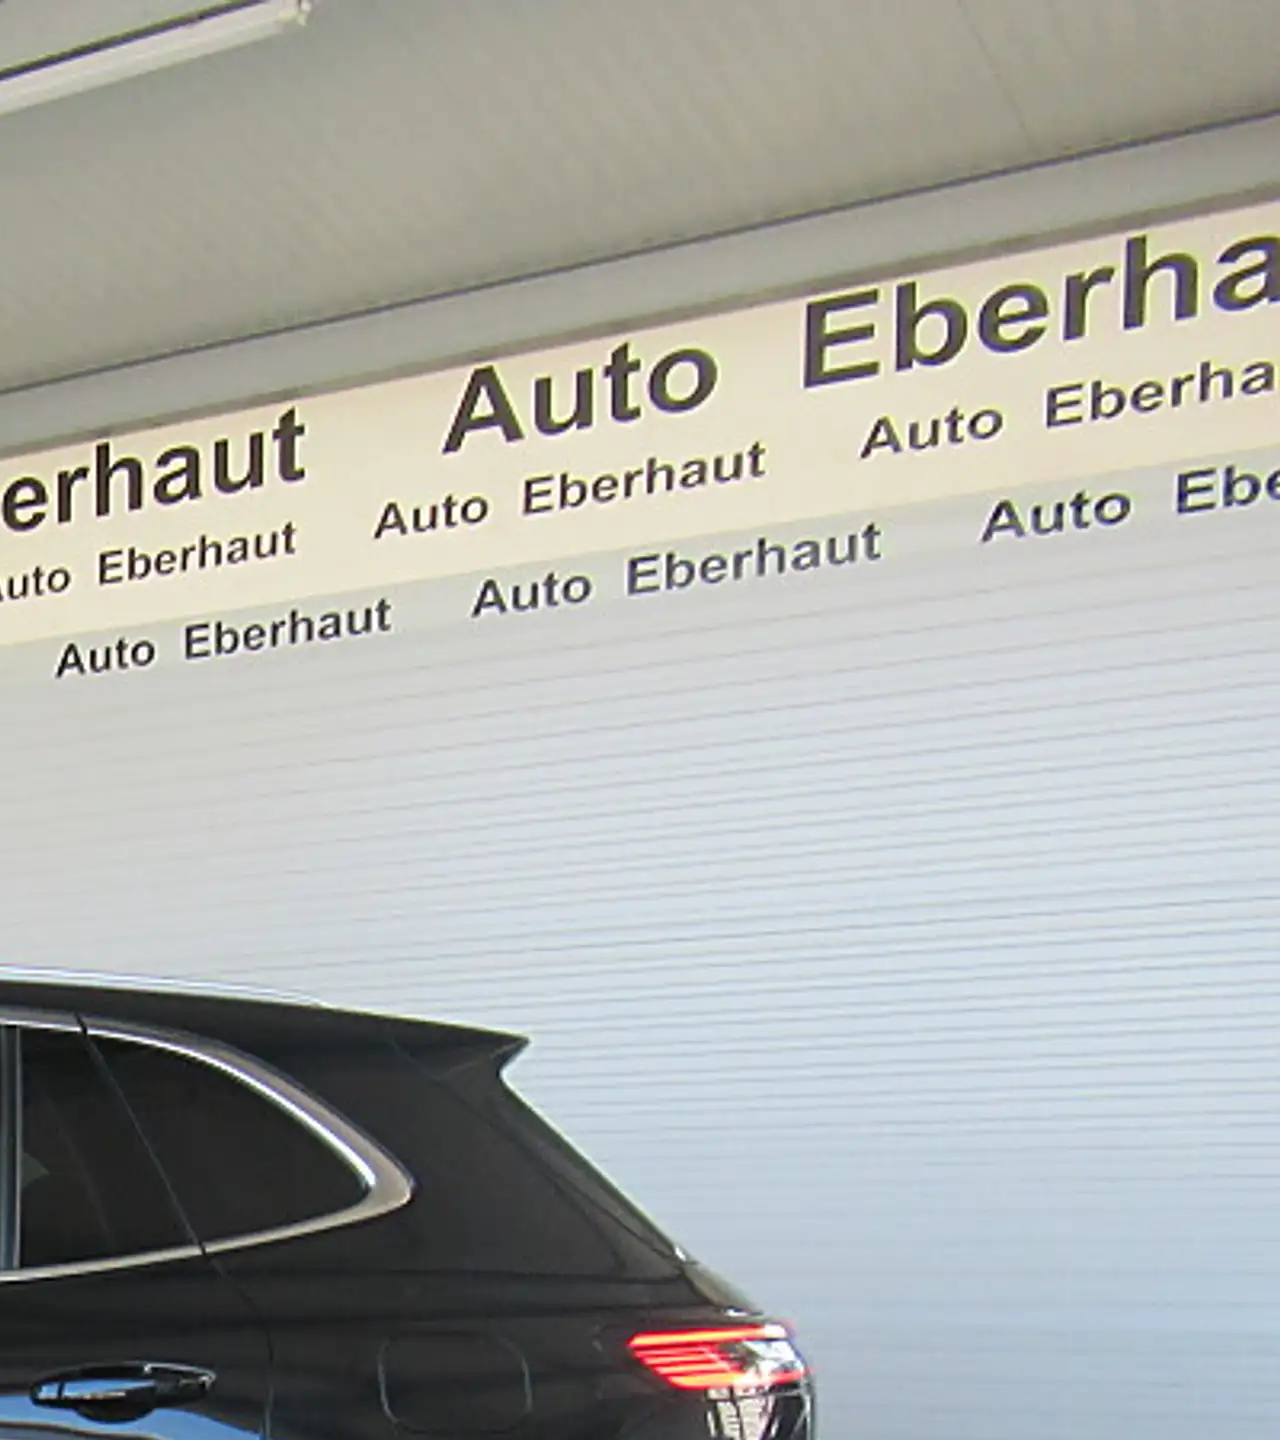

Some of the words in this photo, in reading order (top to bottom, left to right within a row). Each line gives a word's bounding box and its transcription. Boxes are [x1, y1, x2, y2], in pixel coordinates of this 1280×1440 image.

[442, 342, 717, 454] Auto
[860, 408, 1003, 459] Auto
[1046, 361, 1275, 428] Eberha
[374, 495, 488, 539] Auto
[523, 442, 765, 515] Eberhaut
[982, 492, 1131, 543] Auto
[99, 522, 295, 585] Eberhaut
[472, 572, 591, 617] Auto
[628, 523, 881, 595] Eberhaut
[56, 639, 155, 679] Auto
[185, 598, 391, 660] Eberhaut
